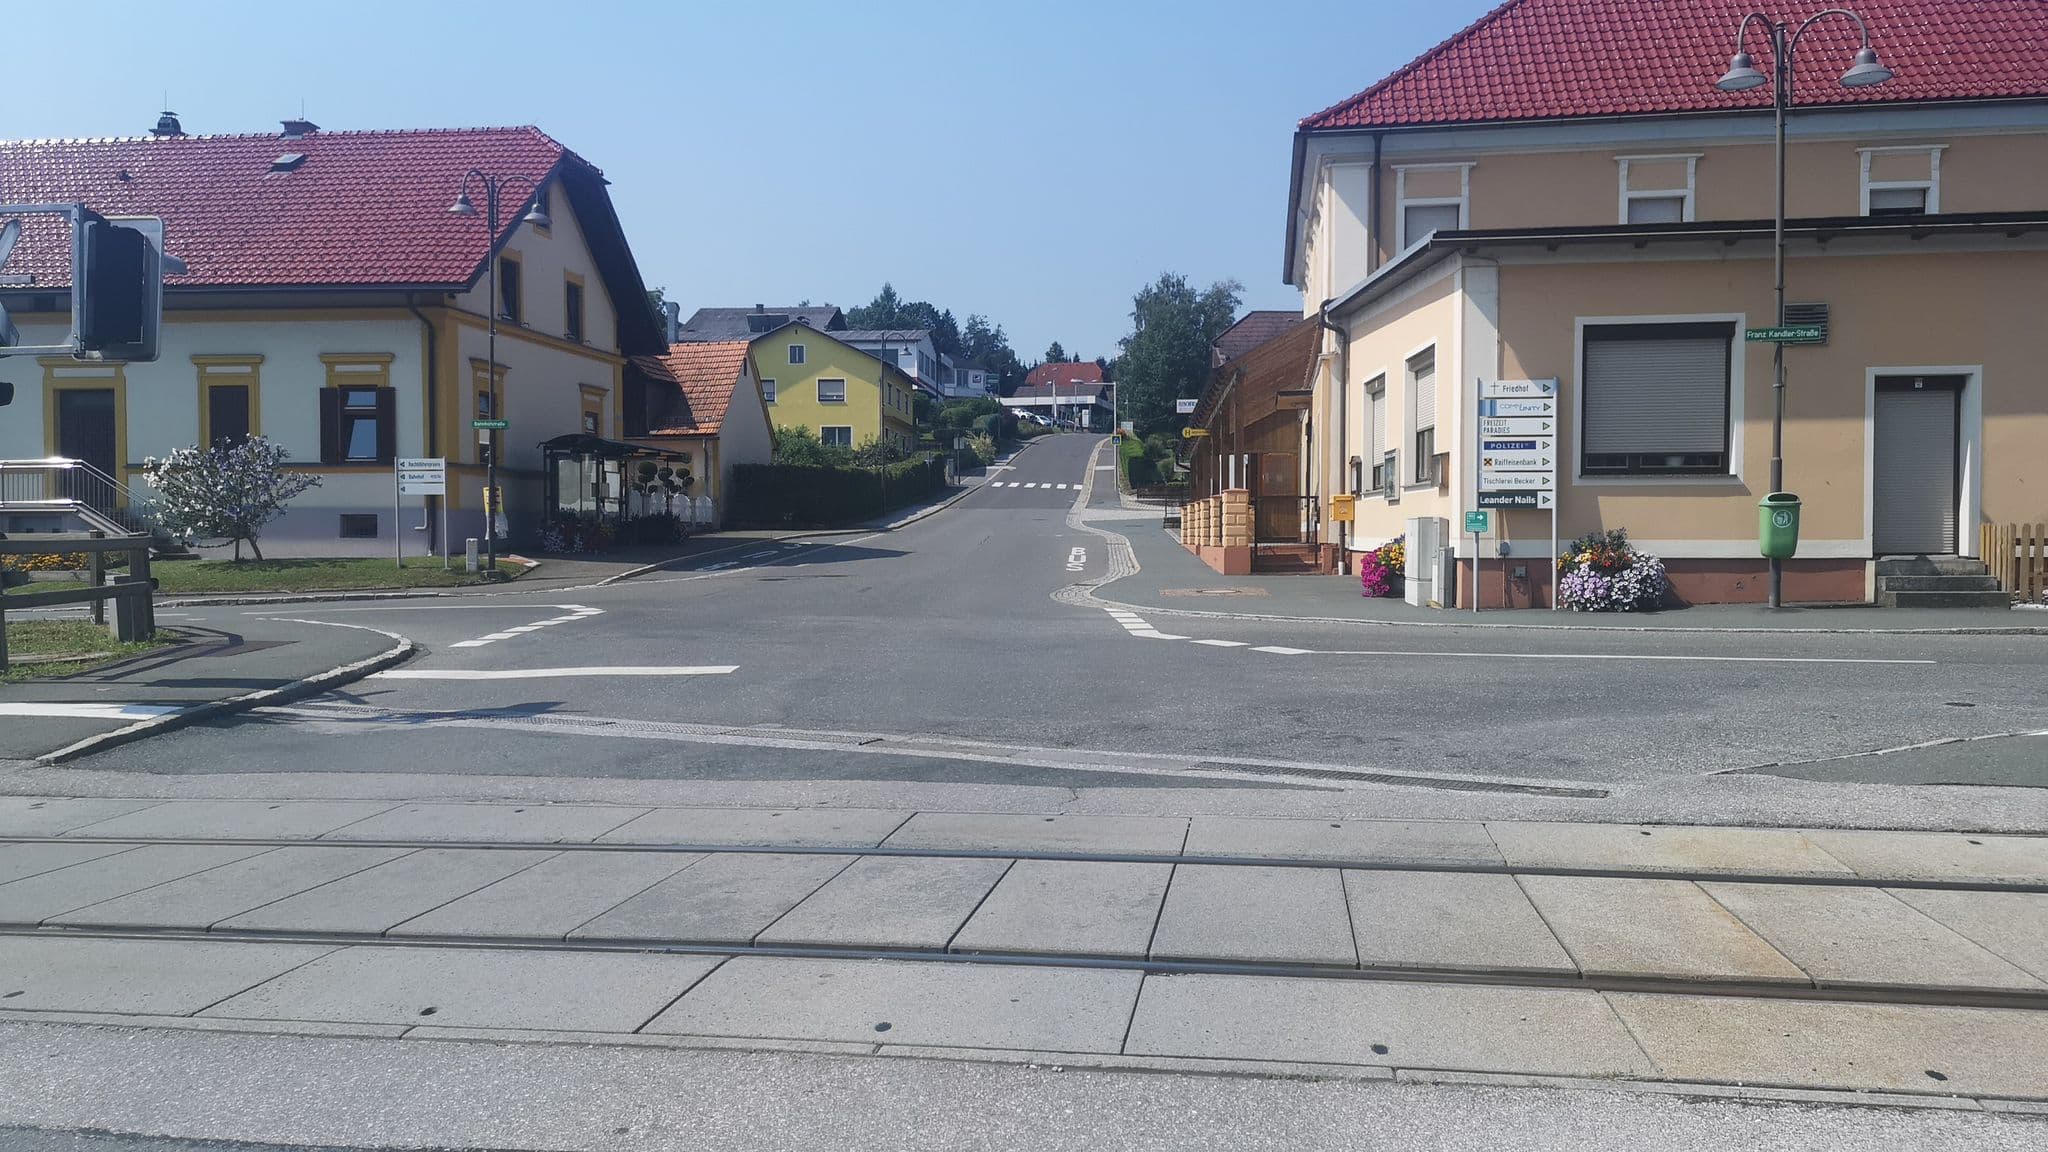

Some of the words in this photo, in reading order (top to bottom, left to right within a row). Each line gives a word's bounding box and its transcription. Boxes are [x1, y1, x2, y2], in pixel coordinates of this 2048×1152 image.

[1502, 384, 1529, 392] Friedhof
[1480, 496, 1513, 504] Leander
[1514, 495, 1536, 504] Nails
[1065, 547, 1087, 571] BUS
